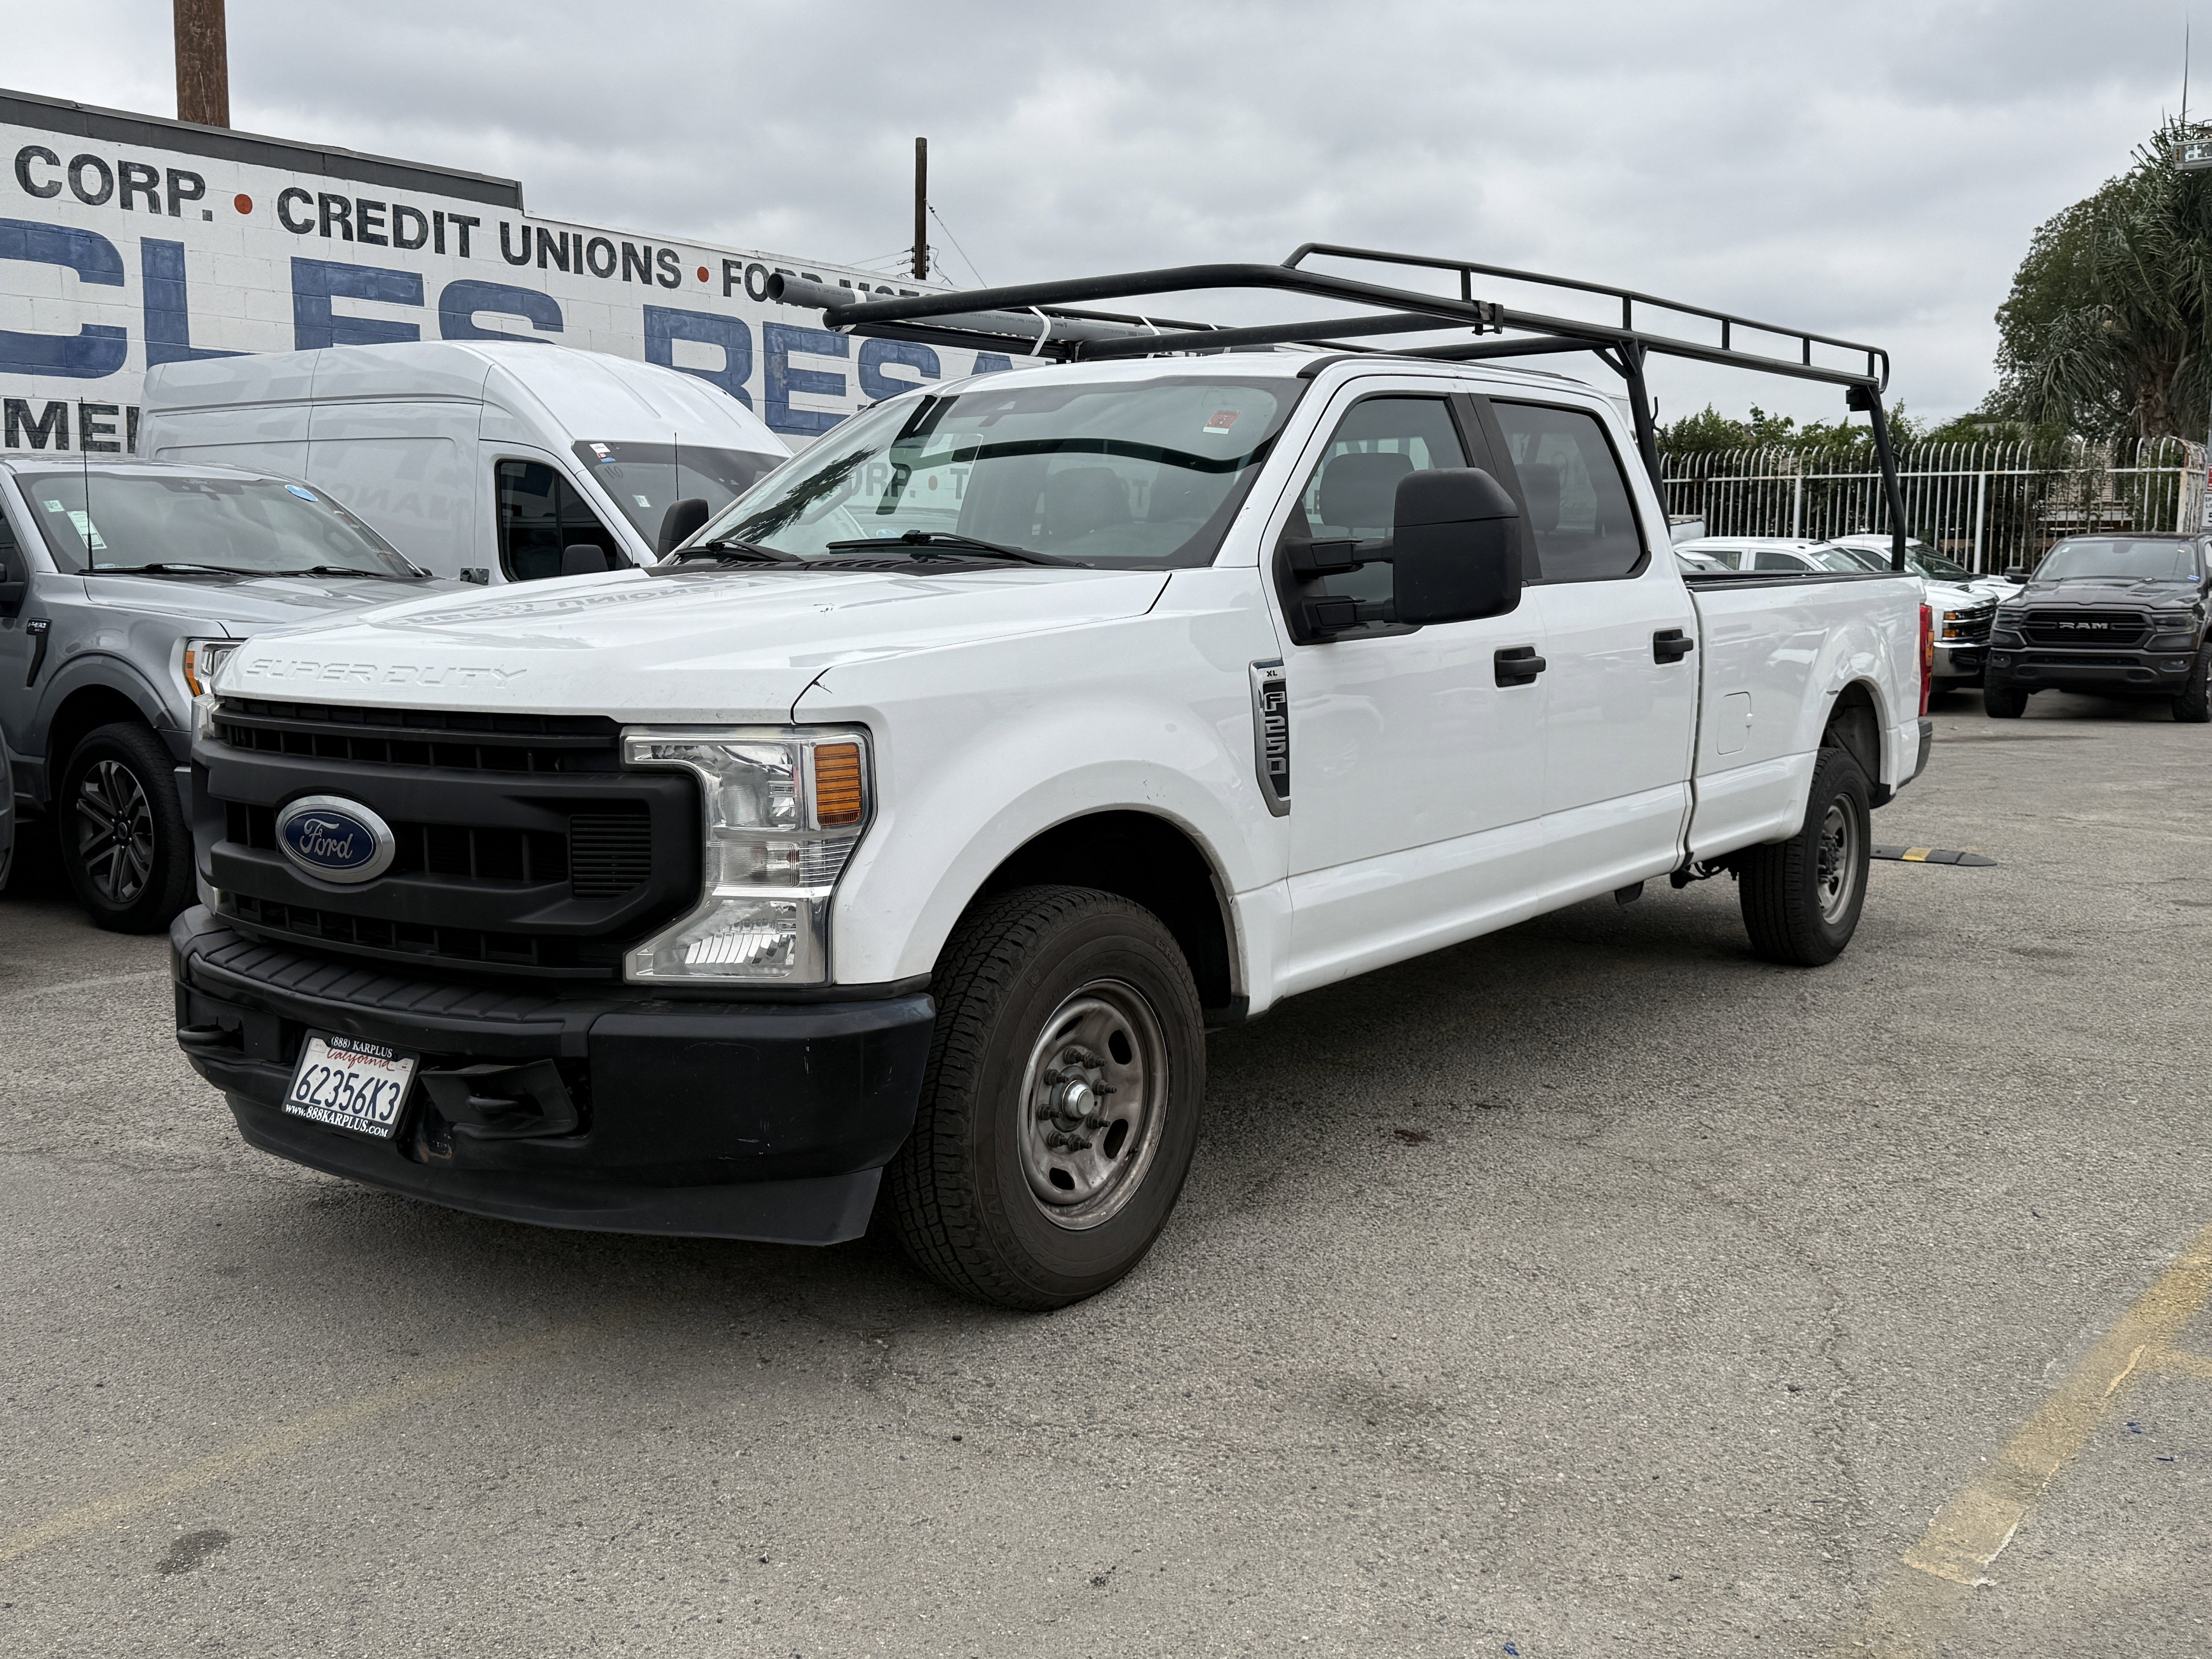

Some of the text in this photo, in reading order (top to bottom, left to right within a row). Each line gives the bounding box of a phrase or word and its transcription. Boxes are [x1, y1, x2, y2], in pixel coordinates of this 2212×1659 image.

[15, 145, 213, 222] CORP.
[277, 187, 481, 259] CREDIT
[500, 222, 682, 289] UNIONS
[246, 659, 527, 688] SUPER DUTY
[299, 818, 353, 859] Ford
[327, 1047, 395, 1072] California
[331, 1036, 393, 1058] (888) KARPLUS
[296, 1064, 400, 1121] 62356K3
